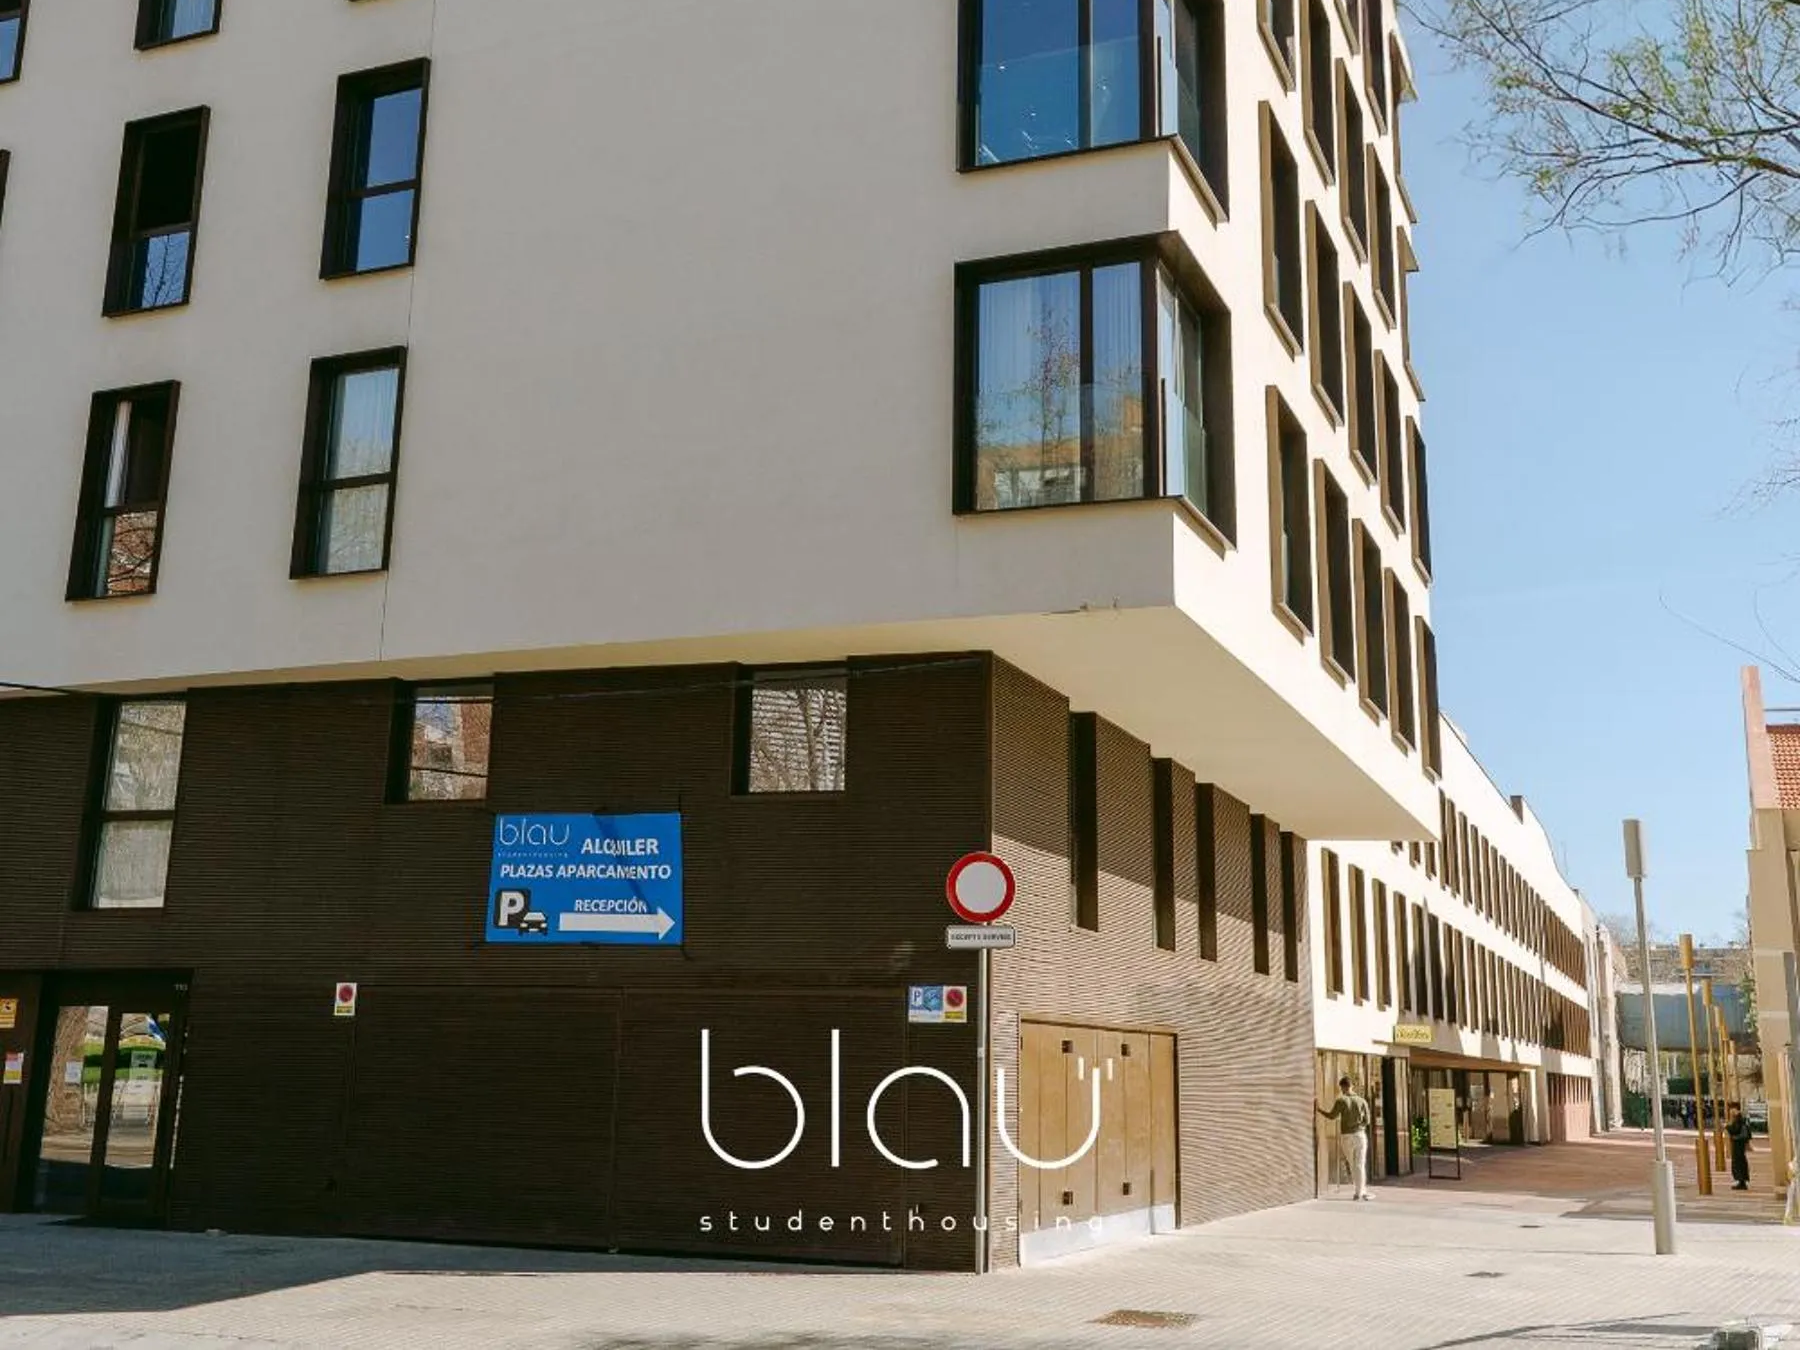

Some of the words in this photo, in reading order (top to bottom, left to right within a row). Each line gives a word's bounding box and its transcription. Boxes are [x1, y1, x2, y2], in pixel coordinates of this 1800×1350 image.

[499, 817, 570, 846] blau
[580, 837, 660, 857] ALQUILER
[500, 864, 553, 878] PLAZAS
[555, 864, 672, 880] APARCAMENTO
[498, 890, 526, 926] P
[574, 896, 647, 913] RECEPCIÓN
